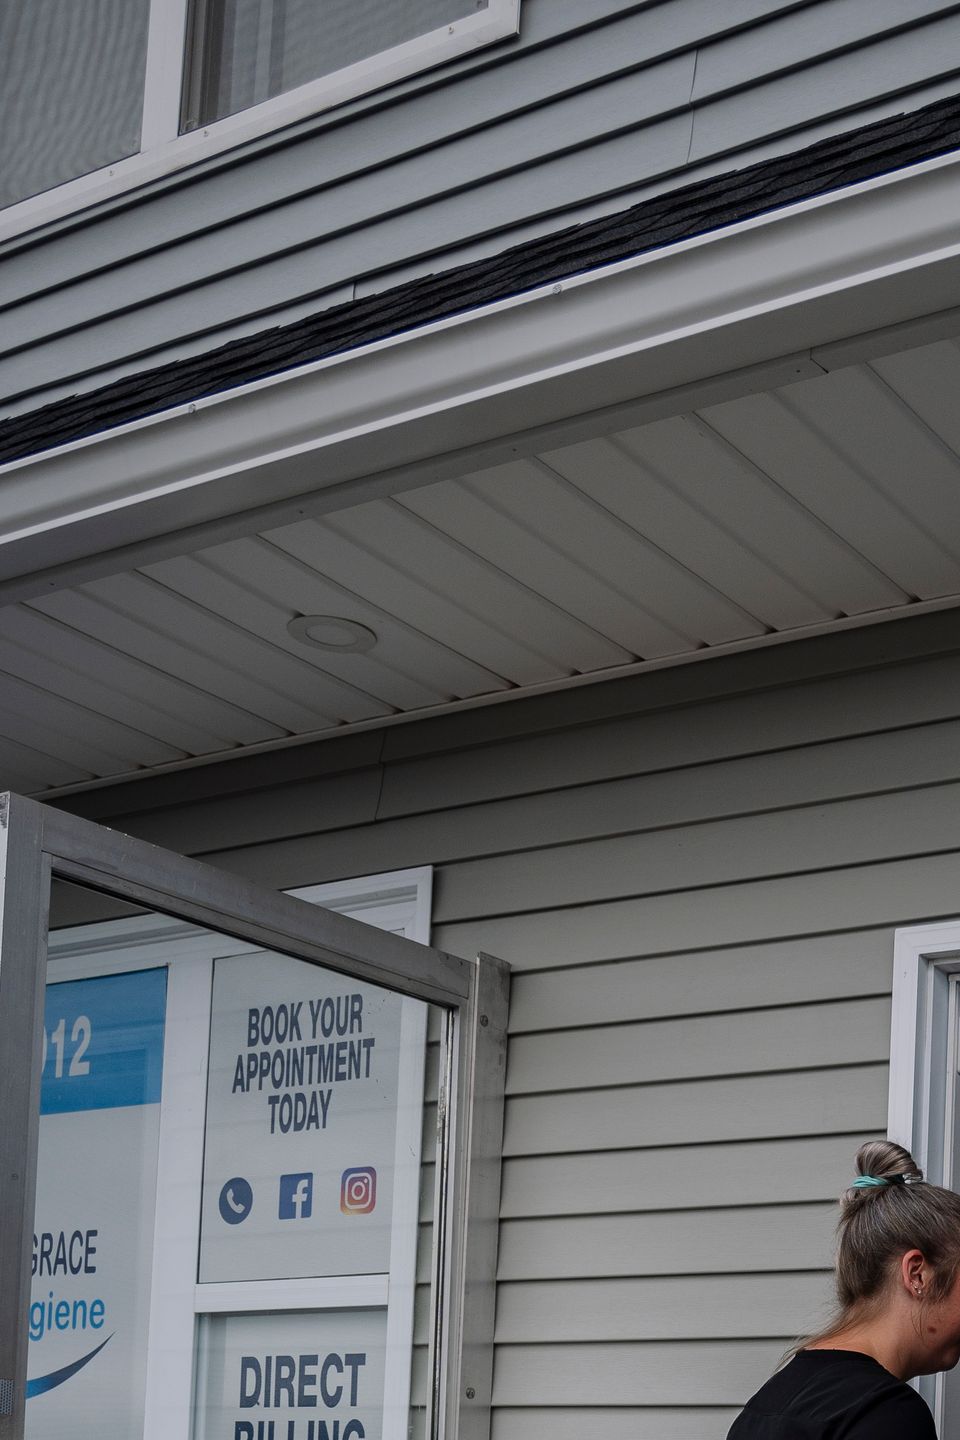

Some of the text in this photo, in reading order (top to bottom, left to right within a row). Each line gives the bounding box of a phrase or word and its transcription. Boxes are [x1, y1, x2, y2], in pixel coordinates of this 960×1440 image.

[41, 1015, 92, 1079] 12
[247, 993, 363, 1047] BOOK YOUR
[232, 1037, 376, 1094] APPOINTMENT
[267, 1088, 333, 1134] TODAY
[239, 1352, 367, 1409] DIRECT
